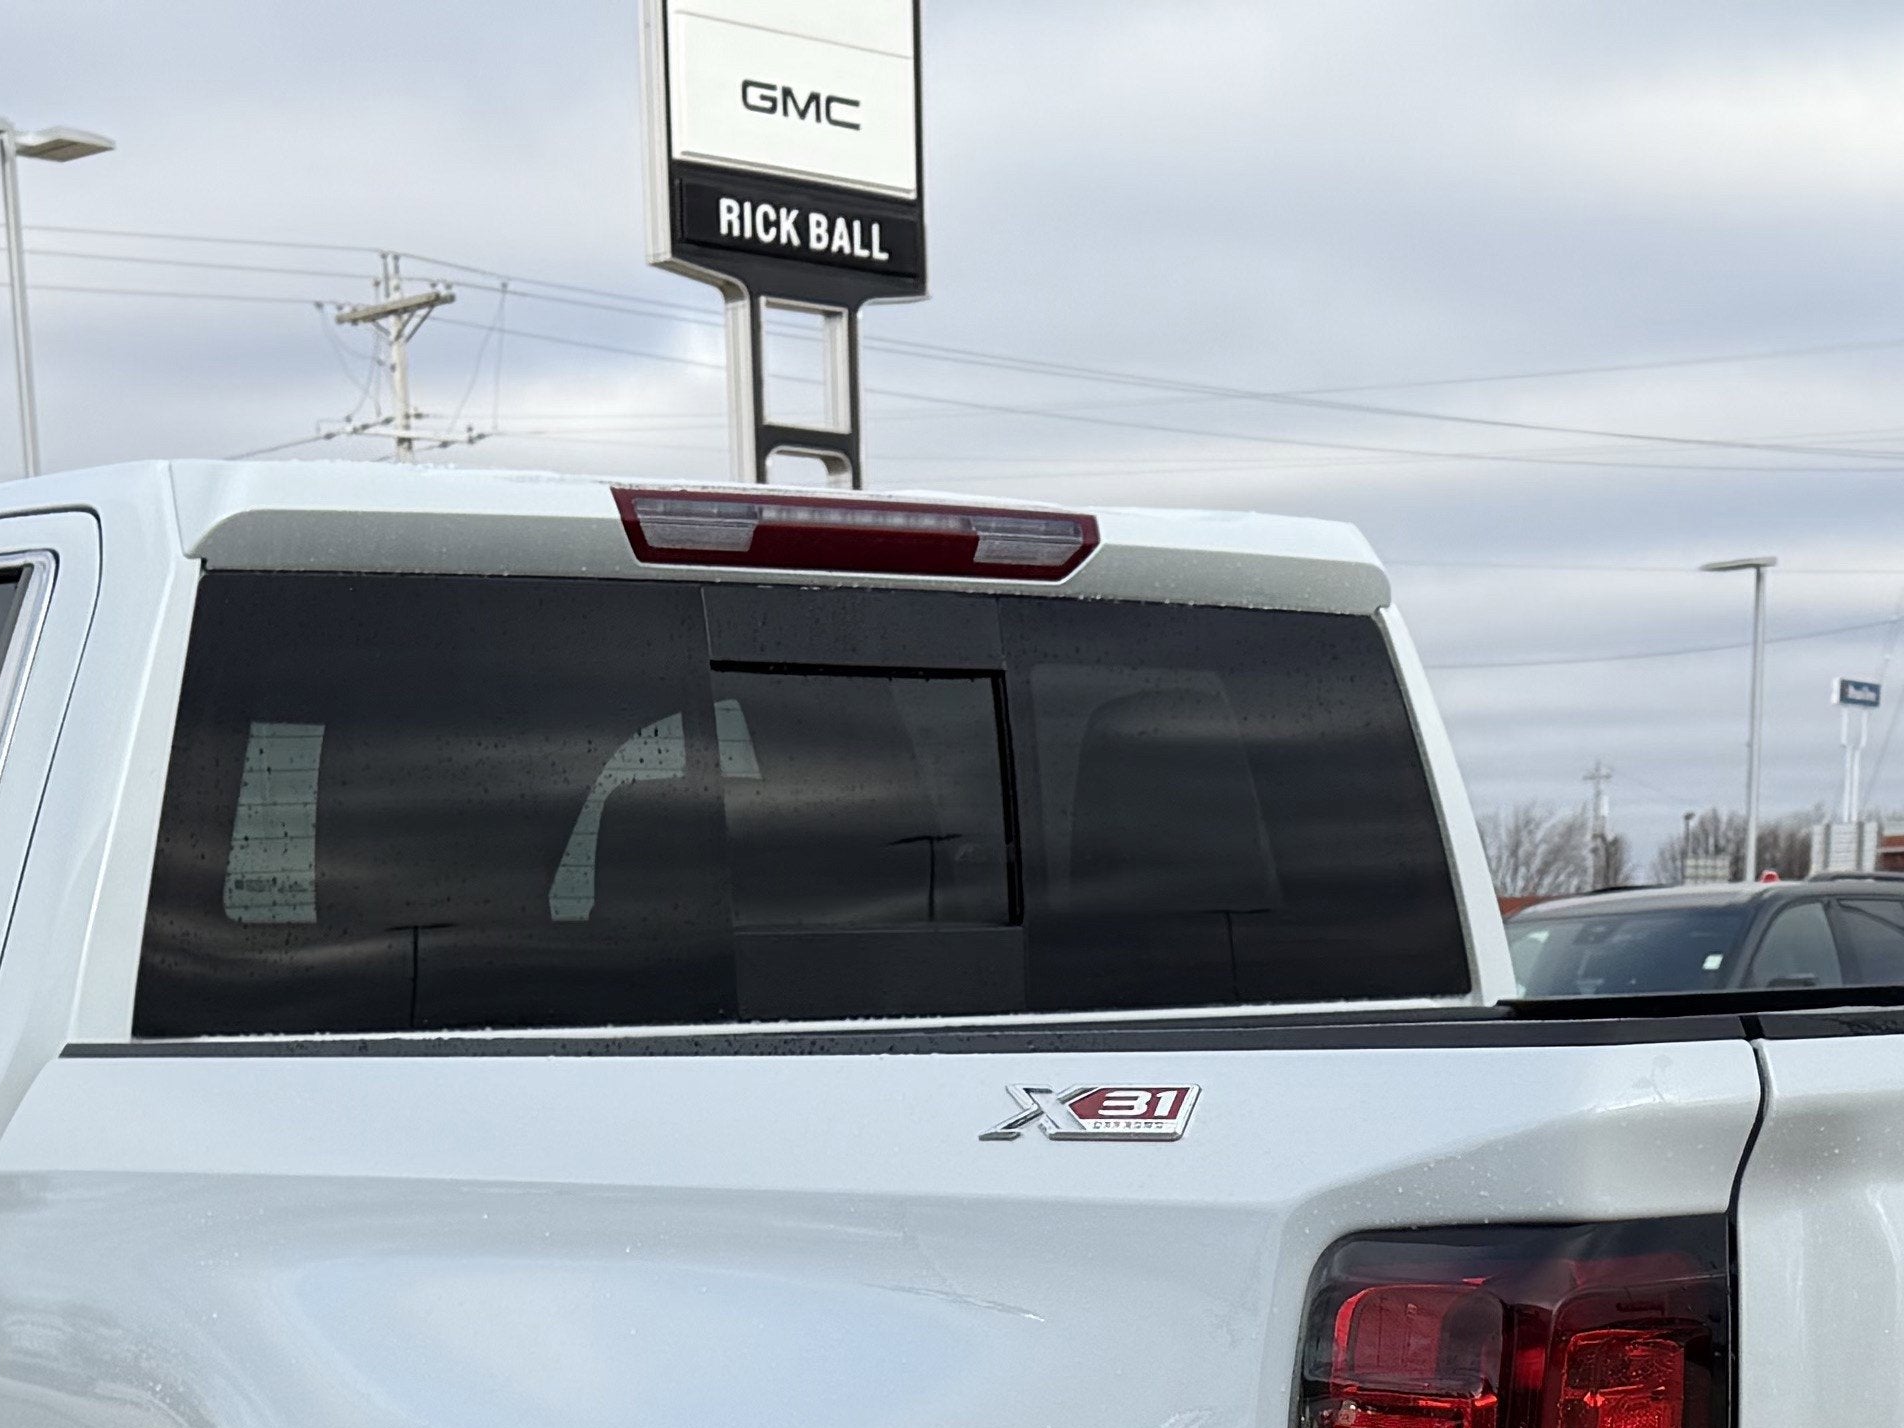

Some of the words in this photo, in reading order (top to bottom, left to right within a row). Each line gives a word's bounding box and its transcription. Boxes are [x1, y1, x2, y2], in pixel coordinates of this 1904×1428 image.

[741, 78, 861, 131] GMC
[718, 197, 801, 247] RICK
[808, 212, 889, 261] BALL
